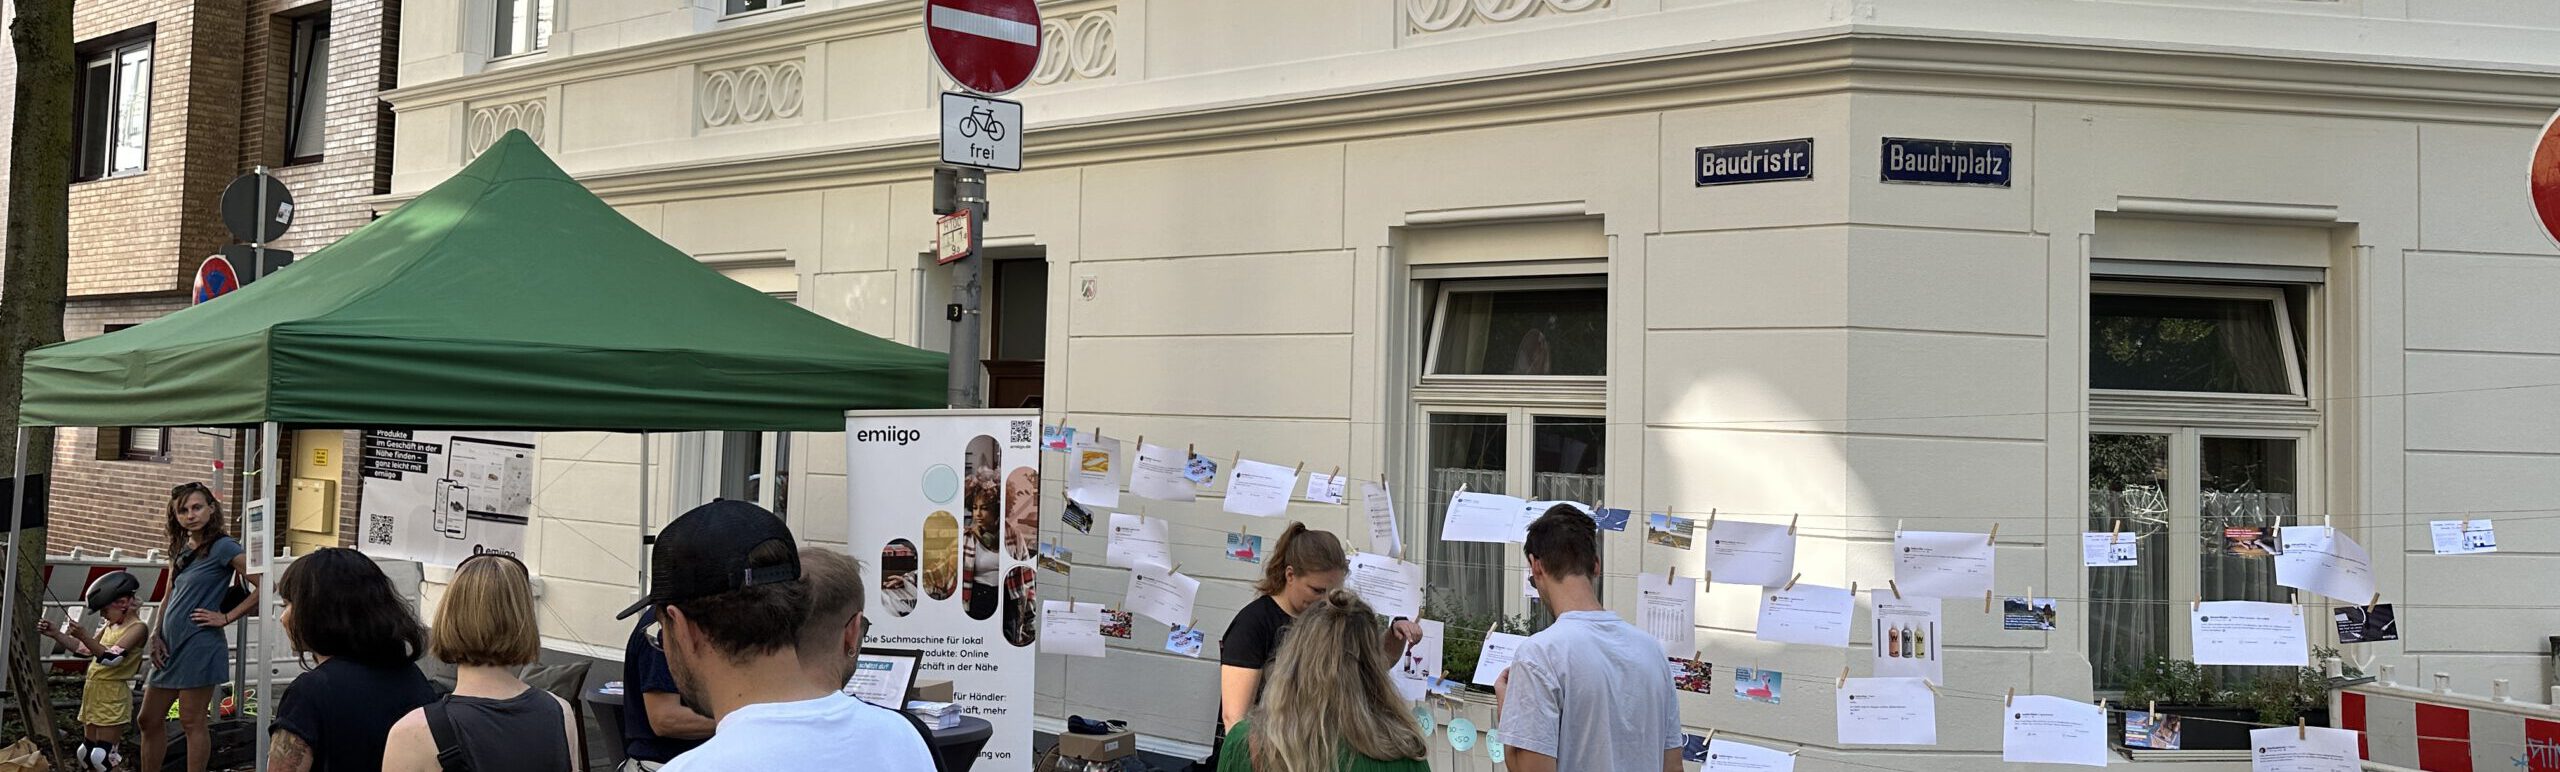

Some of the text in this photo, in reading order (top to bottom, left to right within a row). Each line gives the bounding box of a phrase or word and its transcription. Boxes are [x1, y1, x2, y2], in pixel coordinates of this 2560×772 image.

[970, 143, 994, 160] frei
[1702, 147, 1806, 177] Baudristr.
[1889, 144, 2002, 180] Baudriplatz
[953, 306, 959, 317] 3
[376, 430, 408, 439] Produkte
[857, 425, 921, 446] emiigo
[376, 439, 385, 447] im
[386, 440, 417, 450] Geschäft
[375, 449, 393, 458] Nähe
[394, 451, 416, 460] finden
[374, 460, 391, 468] ganz
[391, 461, 409, 469] leicht
[374, 470, 397, 479] emiigo
[863, 635, 984, 645] Die Suchmaschine für lokal
[924, 649, 989, 658] odukte: Online
[919, 662, 998, 671] schäft in der Nähe
[953, 692, 1007, 701] für Händler:
[983, 707, 1007, 715] mehr
